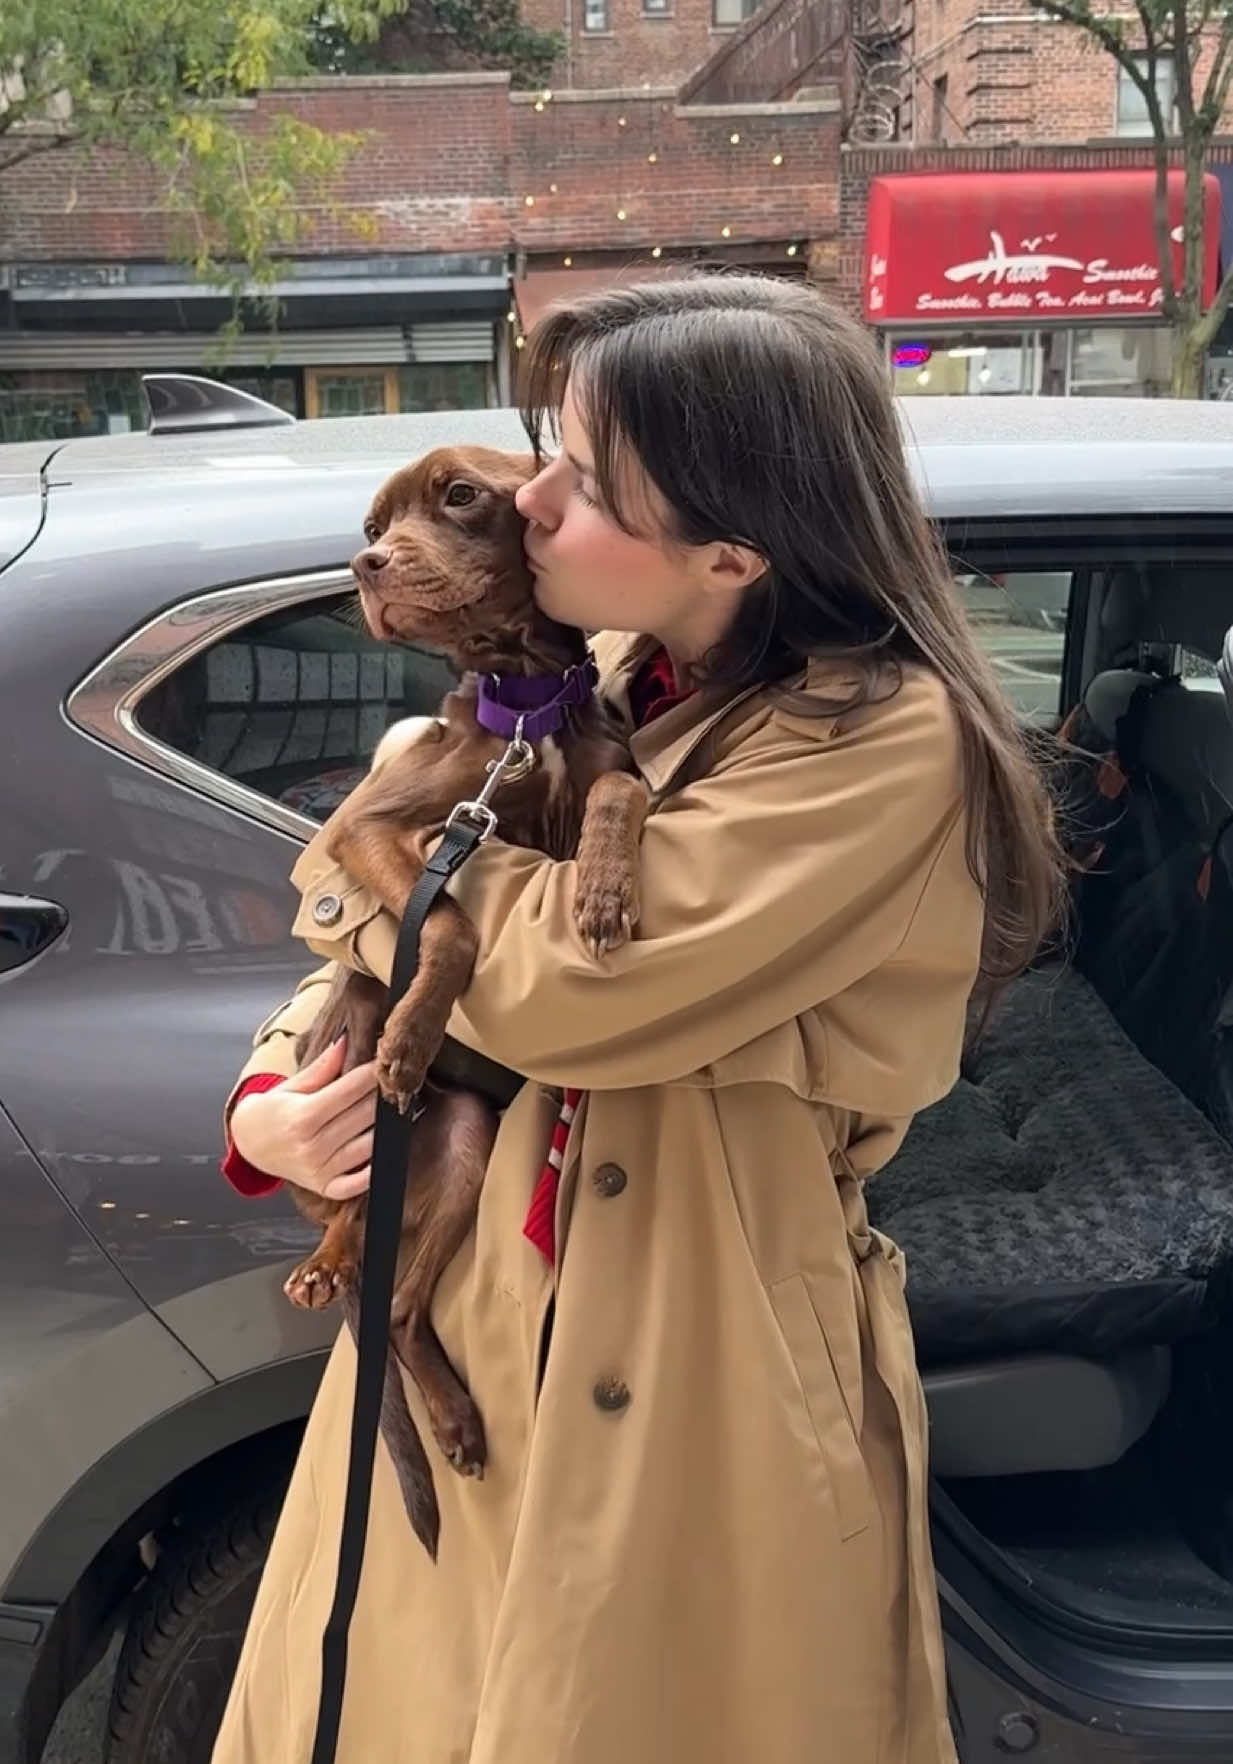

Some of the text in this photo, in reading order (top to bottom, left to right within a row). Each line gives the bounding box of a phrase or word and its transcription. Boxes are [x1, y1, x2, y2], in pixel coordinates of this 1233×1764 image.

[1082, 257, 1159, 284] Smoothie
[986, 291, 1032, 308] Bubble
[1068, 289, 1105, 307] Acai
